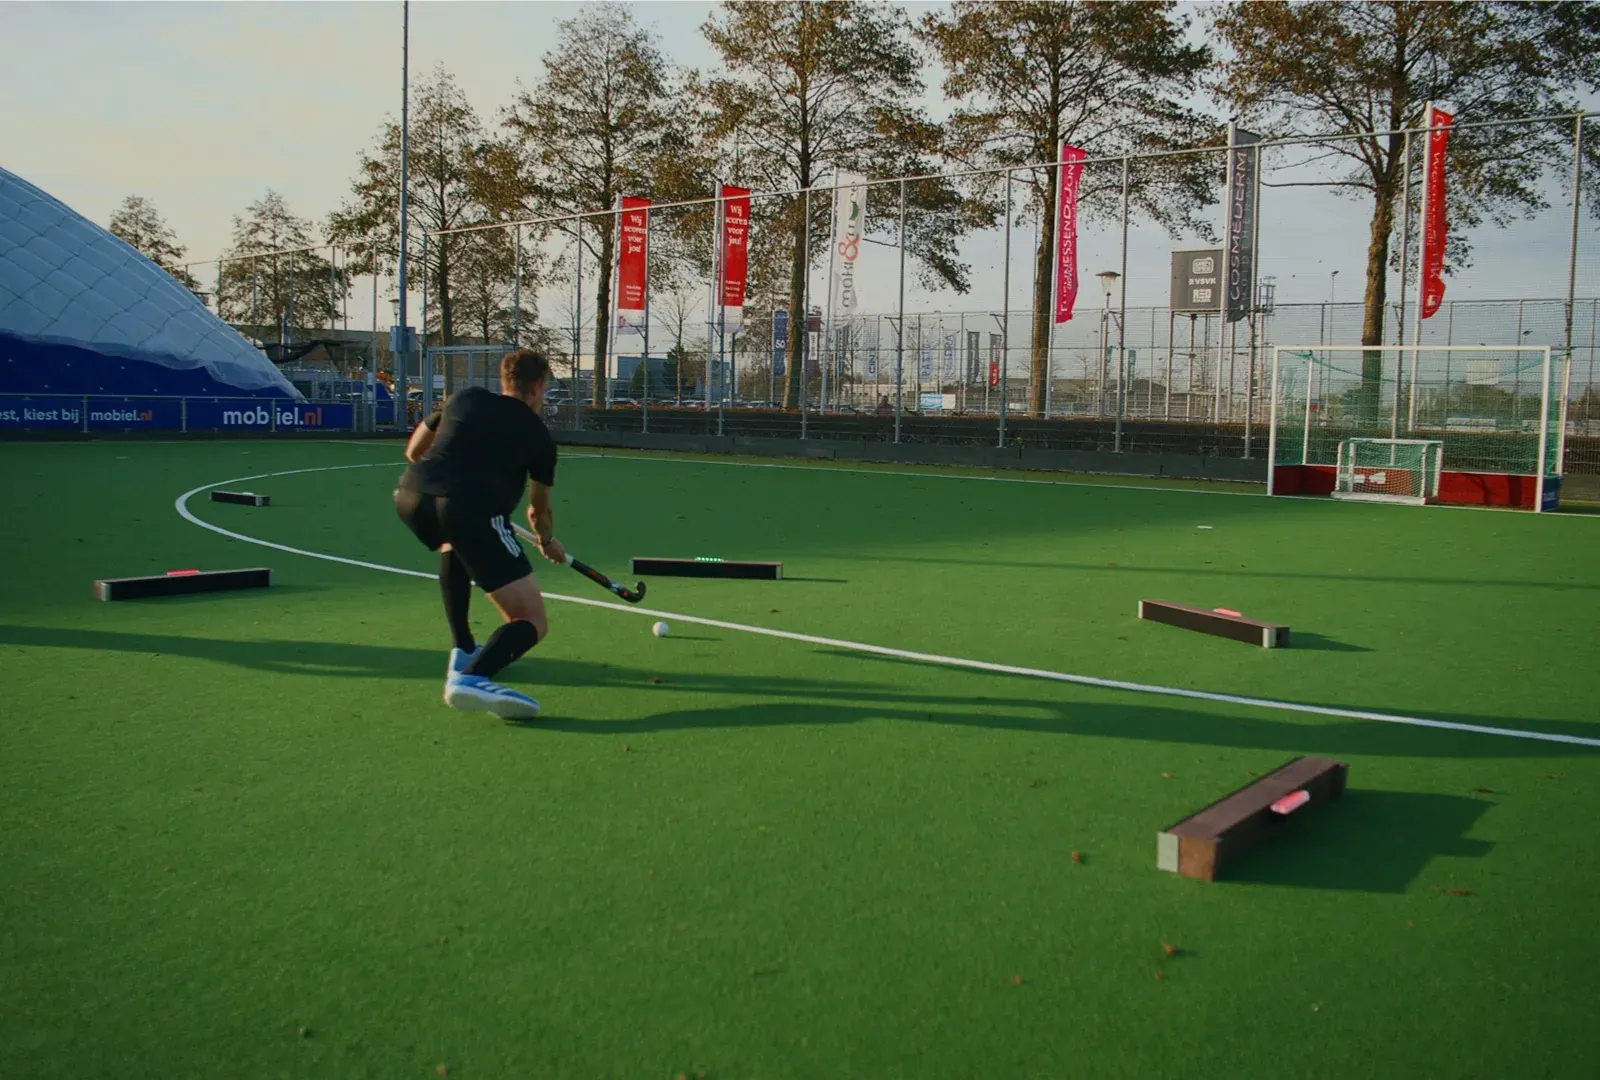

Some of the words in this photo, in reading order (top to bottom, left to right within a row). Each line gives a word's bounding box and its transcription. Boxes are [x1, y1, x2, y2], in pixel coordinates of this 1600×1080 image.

[730, 205, 742, 217] Wij
[630, 215, 642, 226] Wij
[728, 227, 744, 235] voor
[24, 408, 59, 421] kiest
[62, 408, 79, 424] bij
[90, 409, 152, 421] mobiel.nl
[223, 406, 322, 425] mobiel.nl
